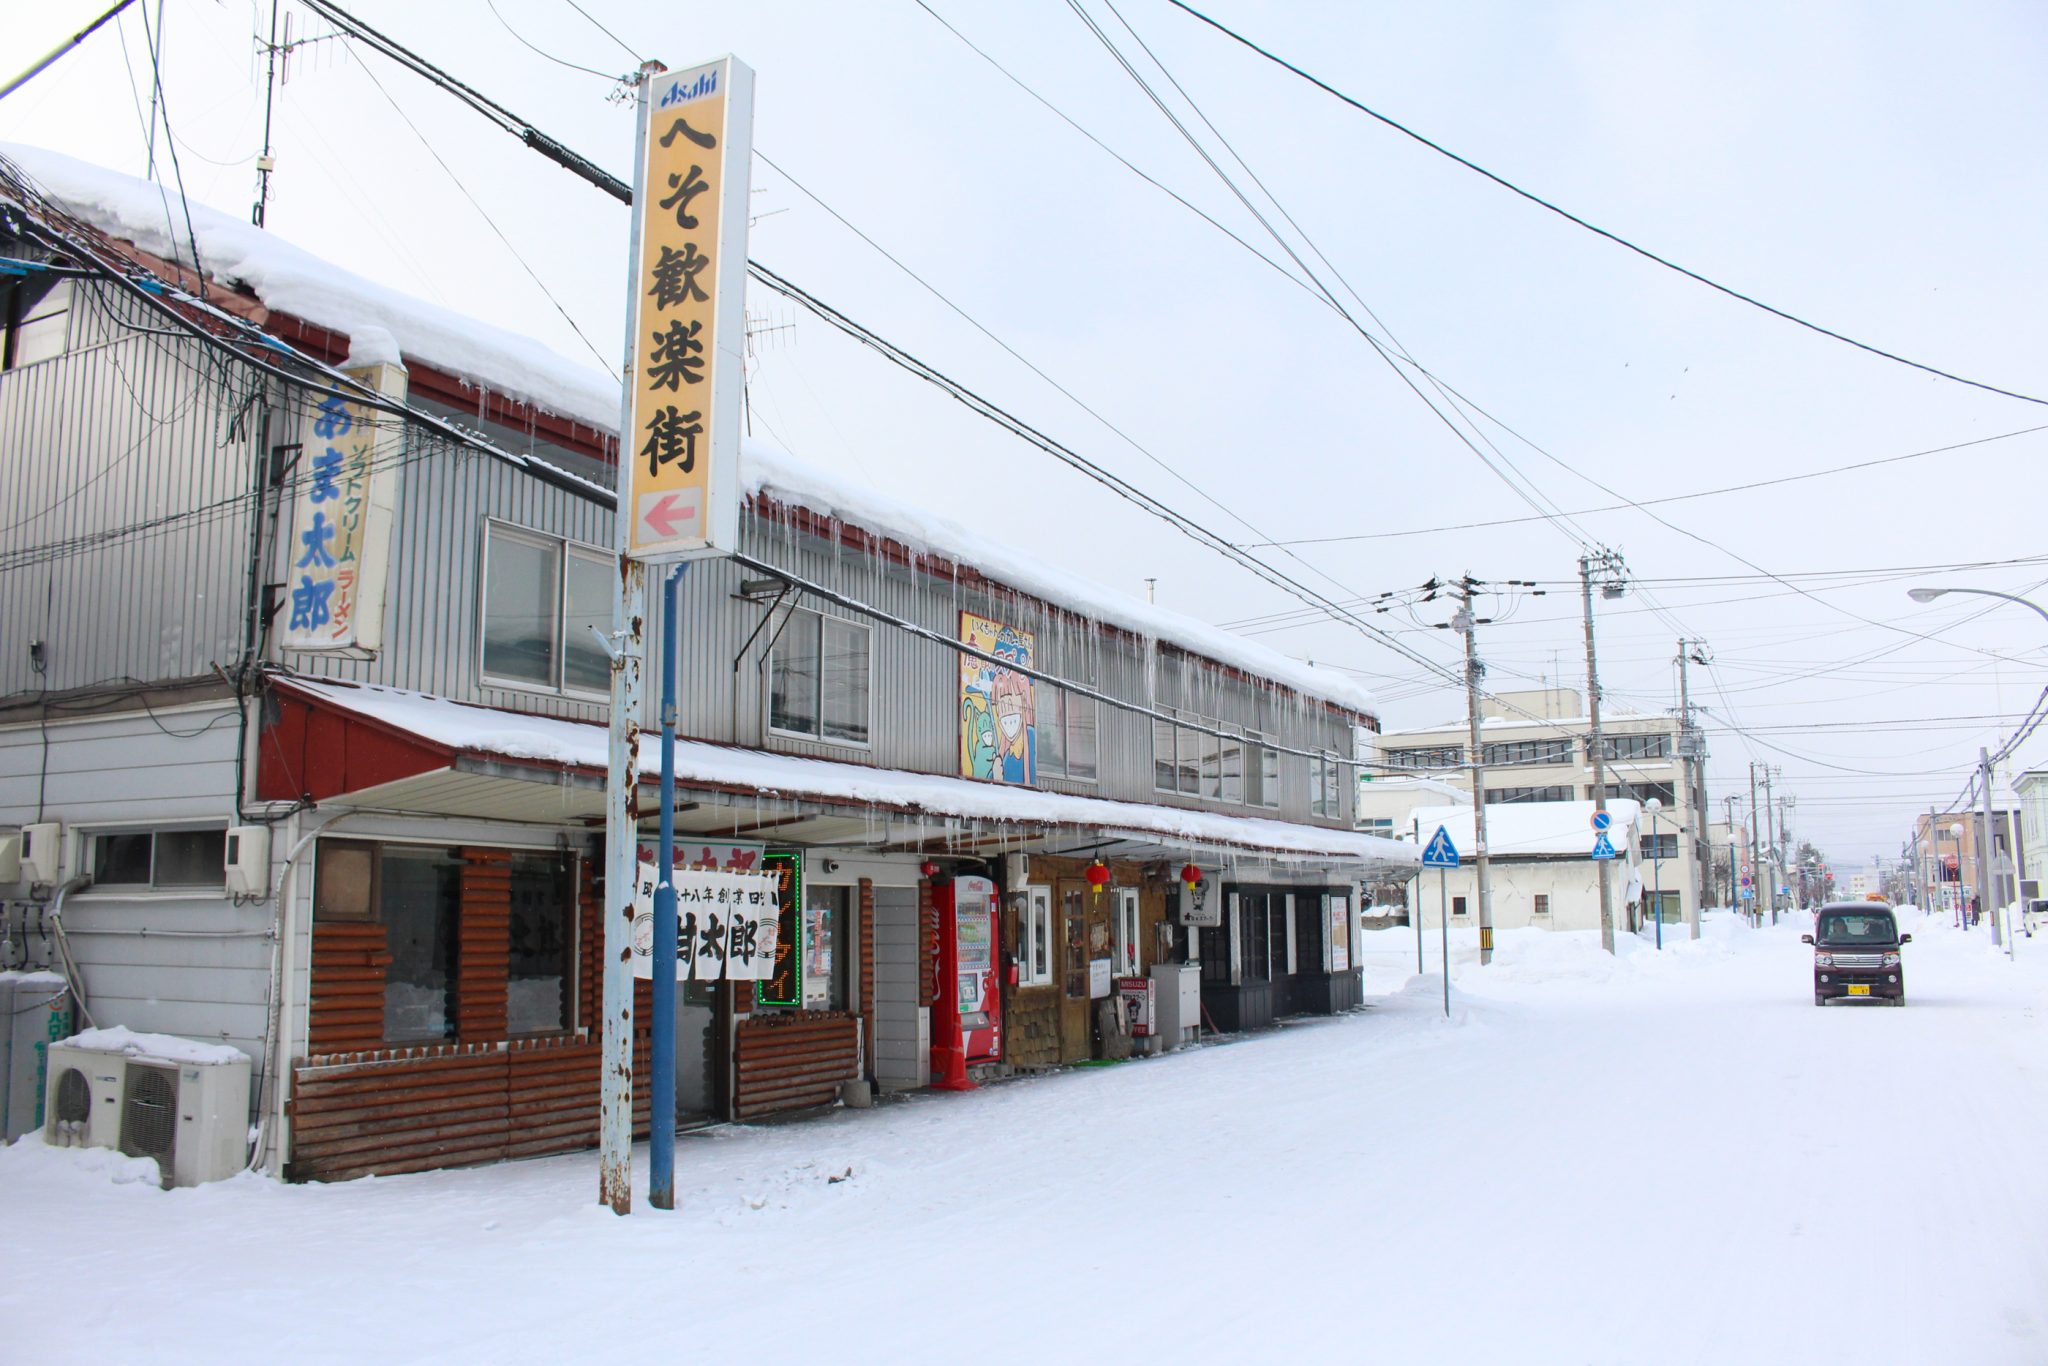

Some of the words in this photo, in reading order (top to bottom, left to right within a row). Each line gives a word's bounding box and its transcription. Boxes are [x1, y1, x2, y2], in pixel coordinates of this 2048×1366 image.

[661, 70, 717, 107] Asahi
[640, 117, 717, 478] へそ歓楽街
[289, 383, 352, 632] あま太郎
[339, 444, 369, 563] ソフトクリーム
[331, 570, 355, 639] ラーメン
[1121, 980, 1147, 988] MISUZU
